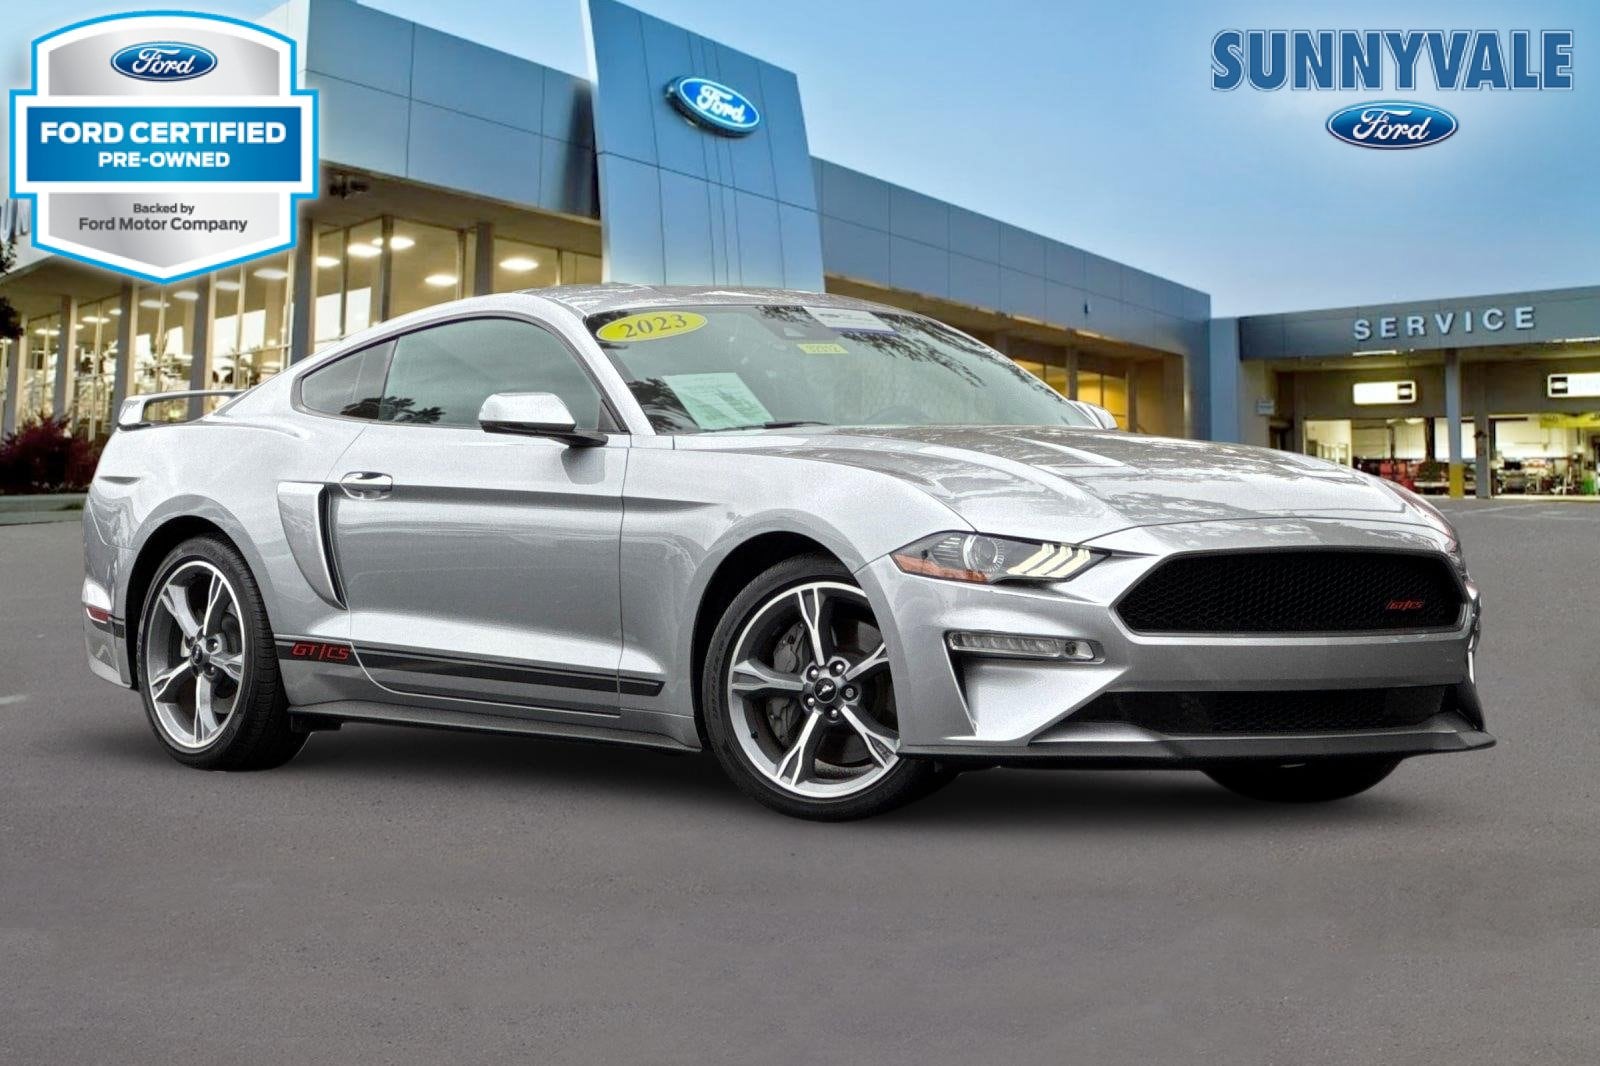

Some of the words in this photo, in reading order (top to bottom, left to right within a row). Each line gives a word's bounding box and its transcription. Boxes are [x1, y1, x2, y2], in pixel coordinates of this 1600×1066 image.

[697, 84, 746, 123] Ford
[619, 313, 687, 338] 2023
[1353, 306, 1536, 341] SERVICE
